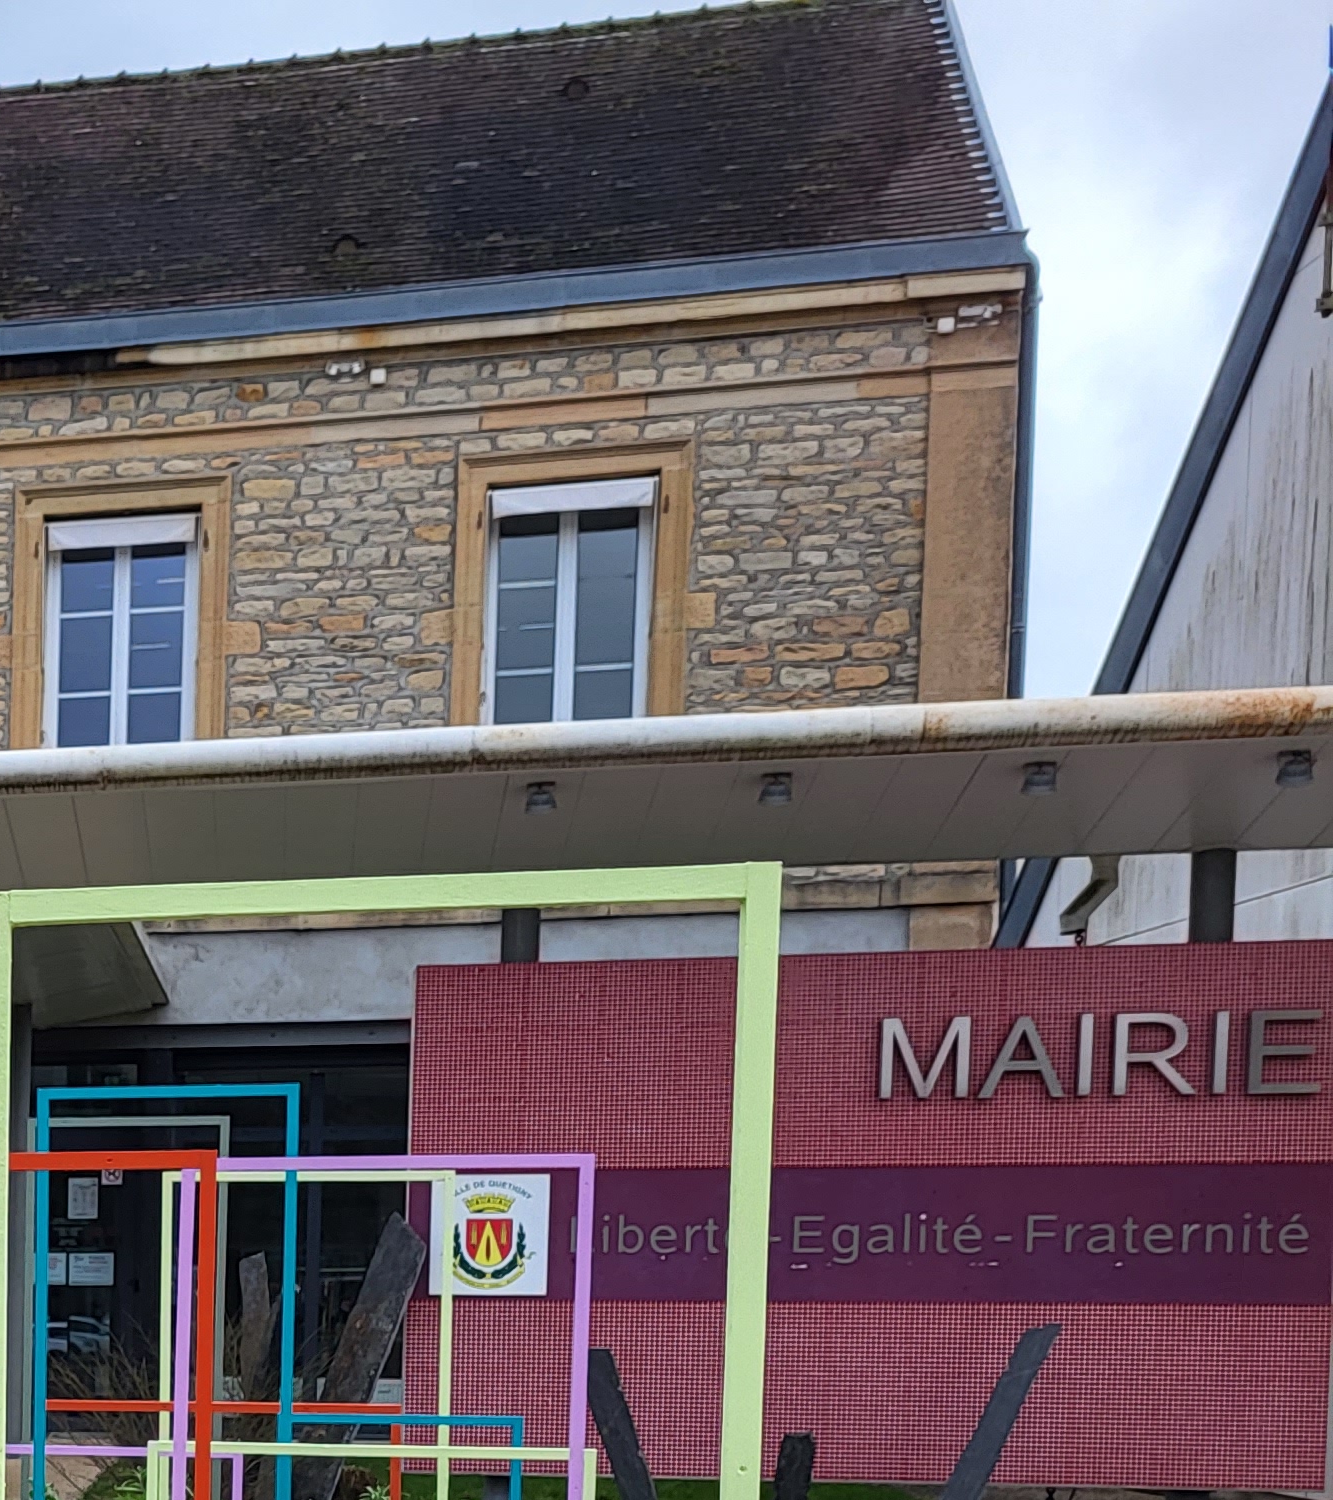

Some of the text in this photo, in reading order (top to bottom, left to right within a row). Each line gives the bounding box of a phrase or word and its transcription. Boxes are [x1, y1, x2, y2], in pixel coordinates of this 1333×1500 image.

[879, 1009, 1323, 1099] MAIRIE
[472, 1180, 485, 1189] DE
[569, 1213, 731, 1255] Libert
[791, 1214, 983, 1264] Egalité
[1026, 1213, 1309, 1254] Fraternité
